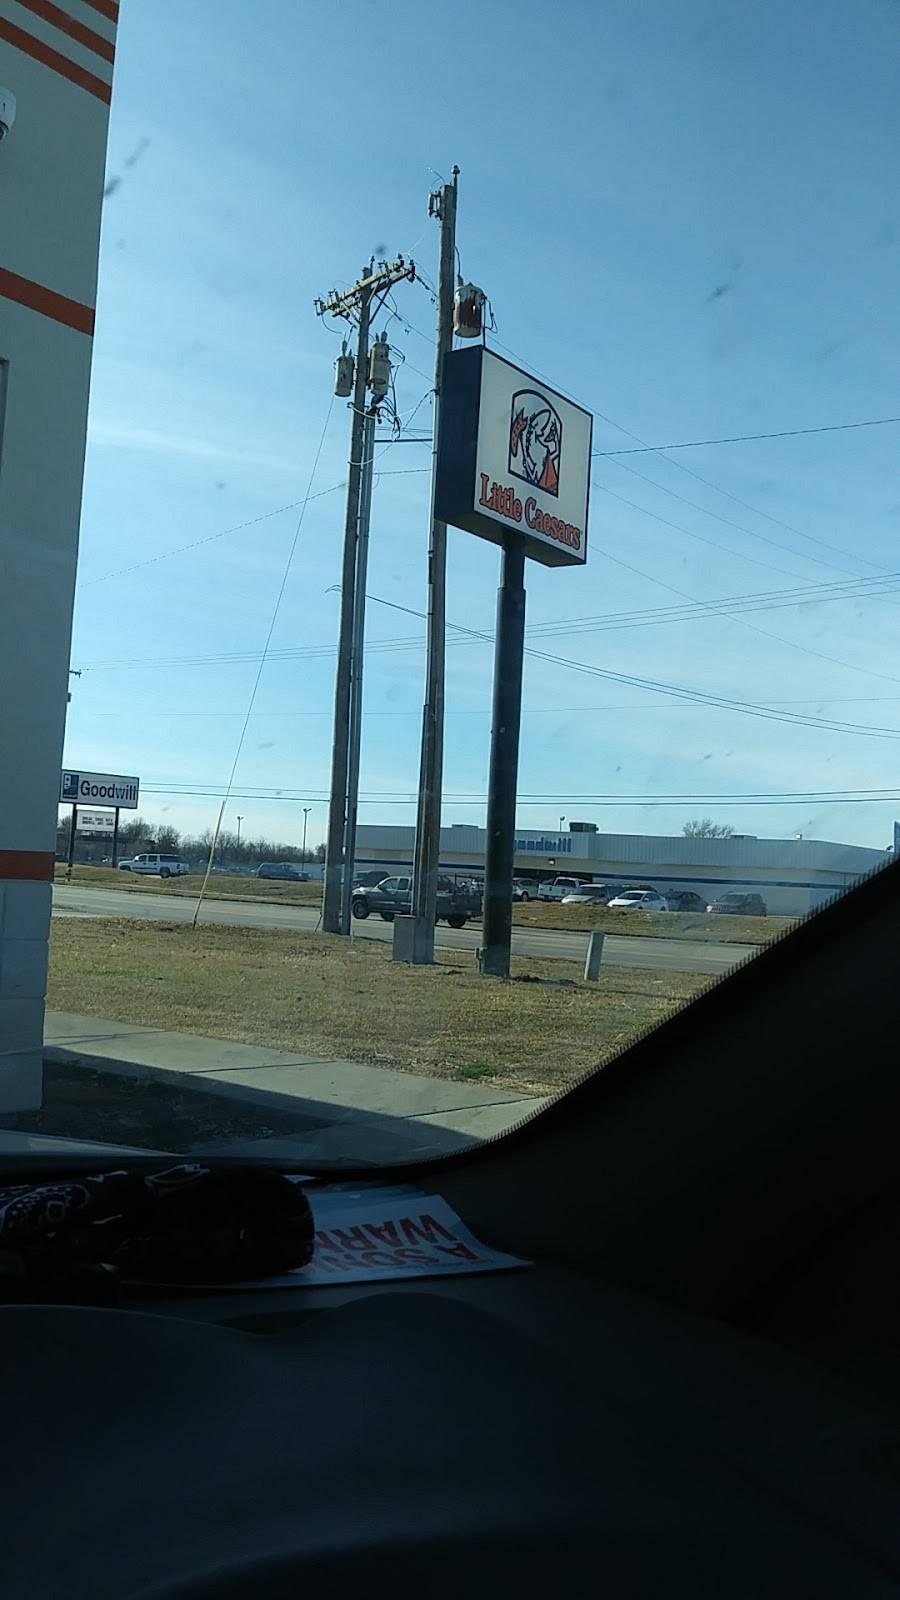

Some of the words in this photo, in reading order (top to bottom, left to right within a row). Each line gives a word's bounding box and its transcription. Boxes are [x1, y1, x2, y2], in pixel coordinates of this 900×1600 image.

[479, 473, 522, 522] Little
[525, 496, 580, 550] Caesars
[80, 780, 136, 800] Goodwill
